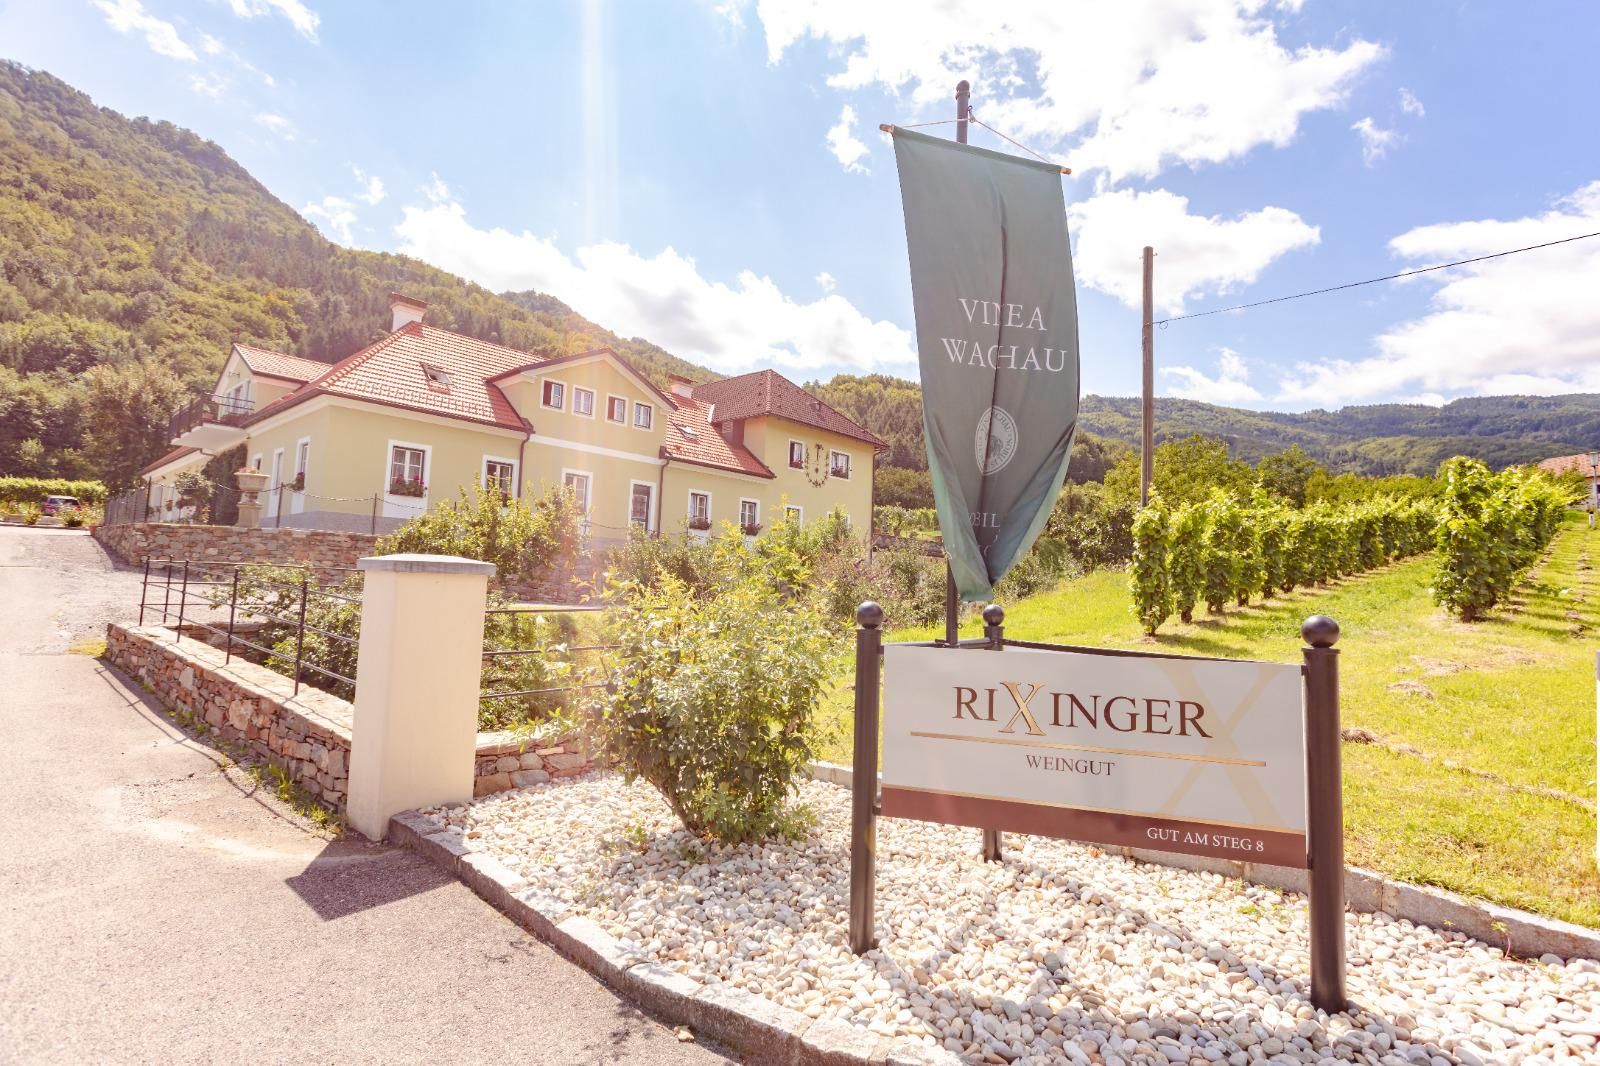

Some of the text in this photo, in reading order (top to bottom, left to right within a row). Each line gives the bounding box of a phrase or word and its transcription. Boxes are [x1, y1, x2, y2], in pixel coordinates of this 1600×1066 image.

[958, 298, 1048, 331] VINEA
[941, 337, 1068, 372] WACHAU
[951, 681, 1213, 739] RIXINGER
[1026, 754, 1116, 776] WEINGUT
[1146, 827, 1265, 852] GUT AM STEG 8
